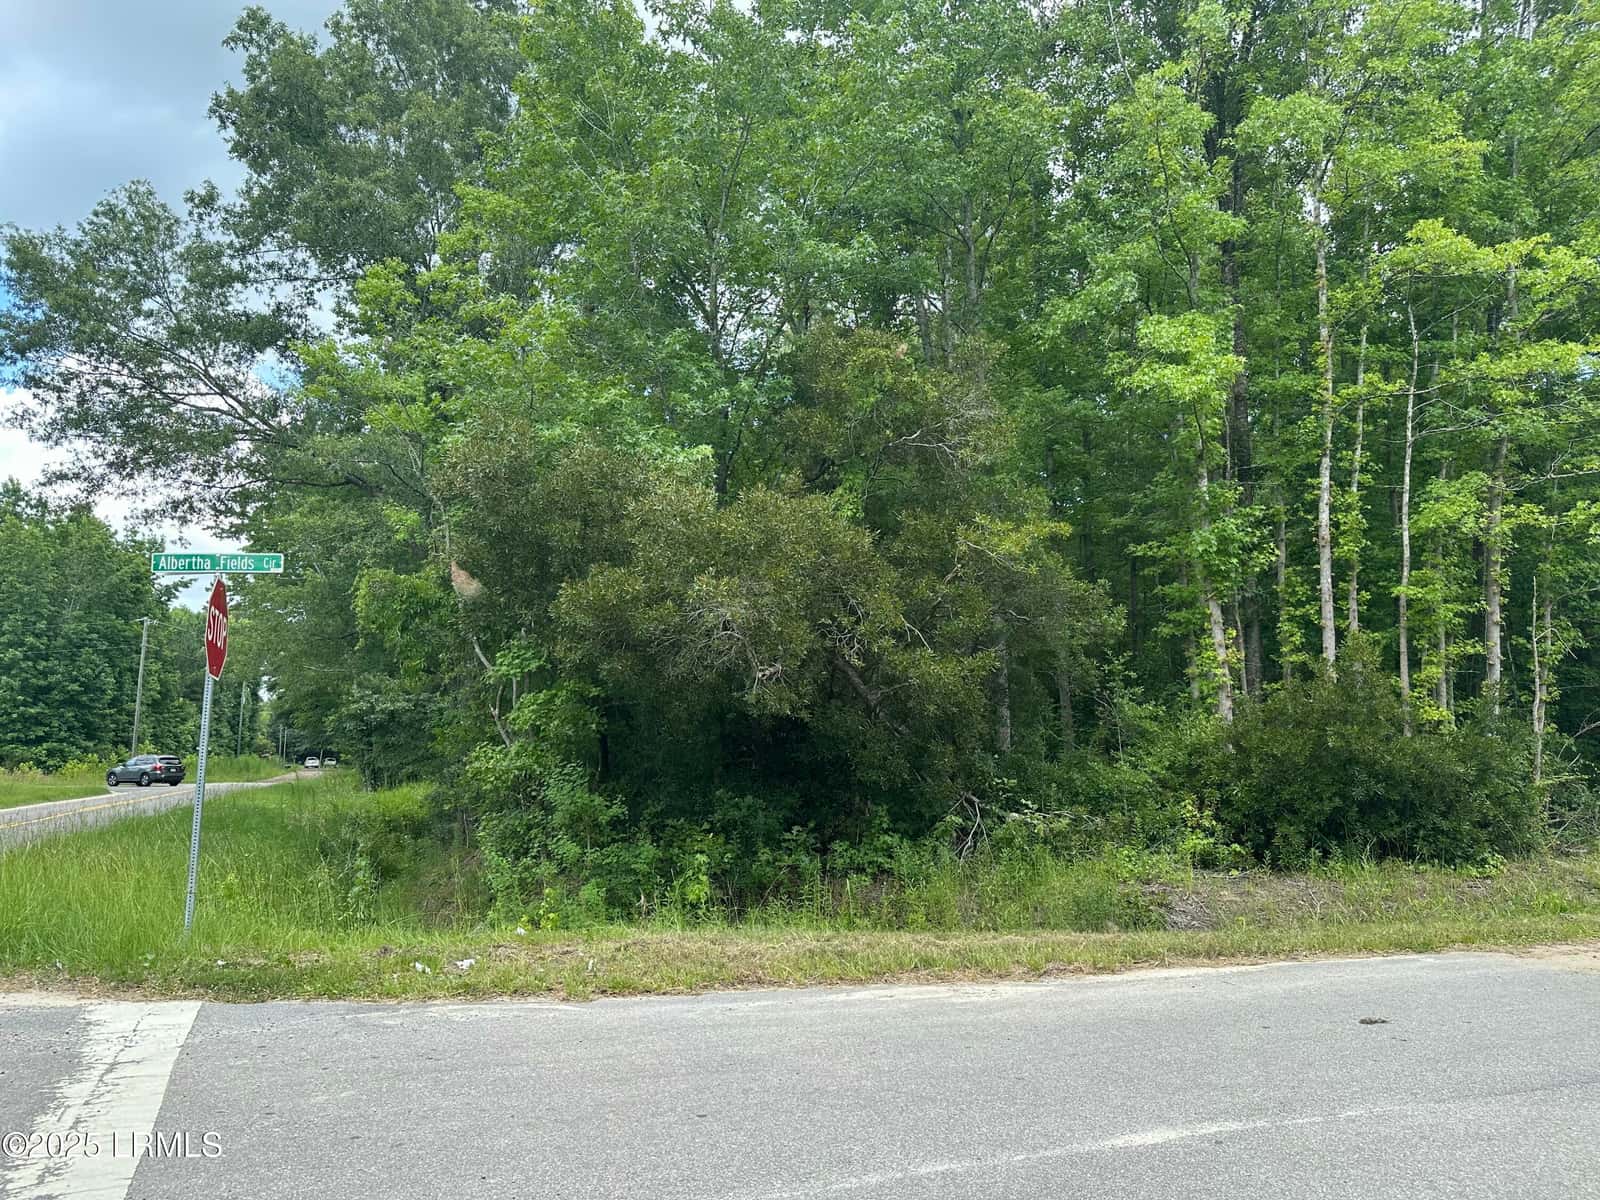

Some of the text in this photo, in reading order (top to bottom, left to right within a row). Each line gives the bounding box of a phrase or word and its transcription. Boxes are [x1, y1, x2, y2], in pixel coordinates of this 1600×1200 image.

[158, 555, 276, 570] Albertha Fields Cir
[208, 605, 227, 650] STOP
